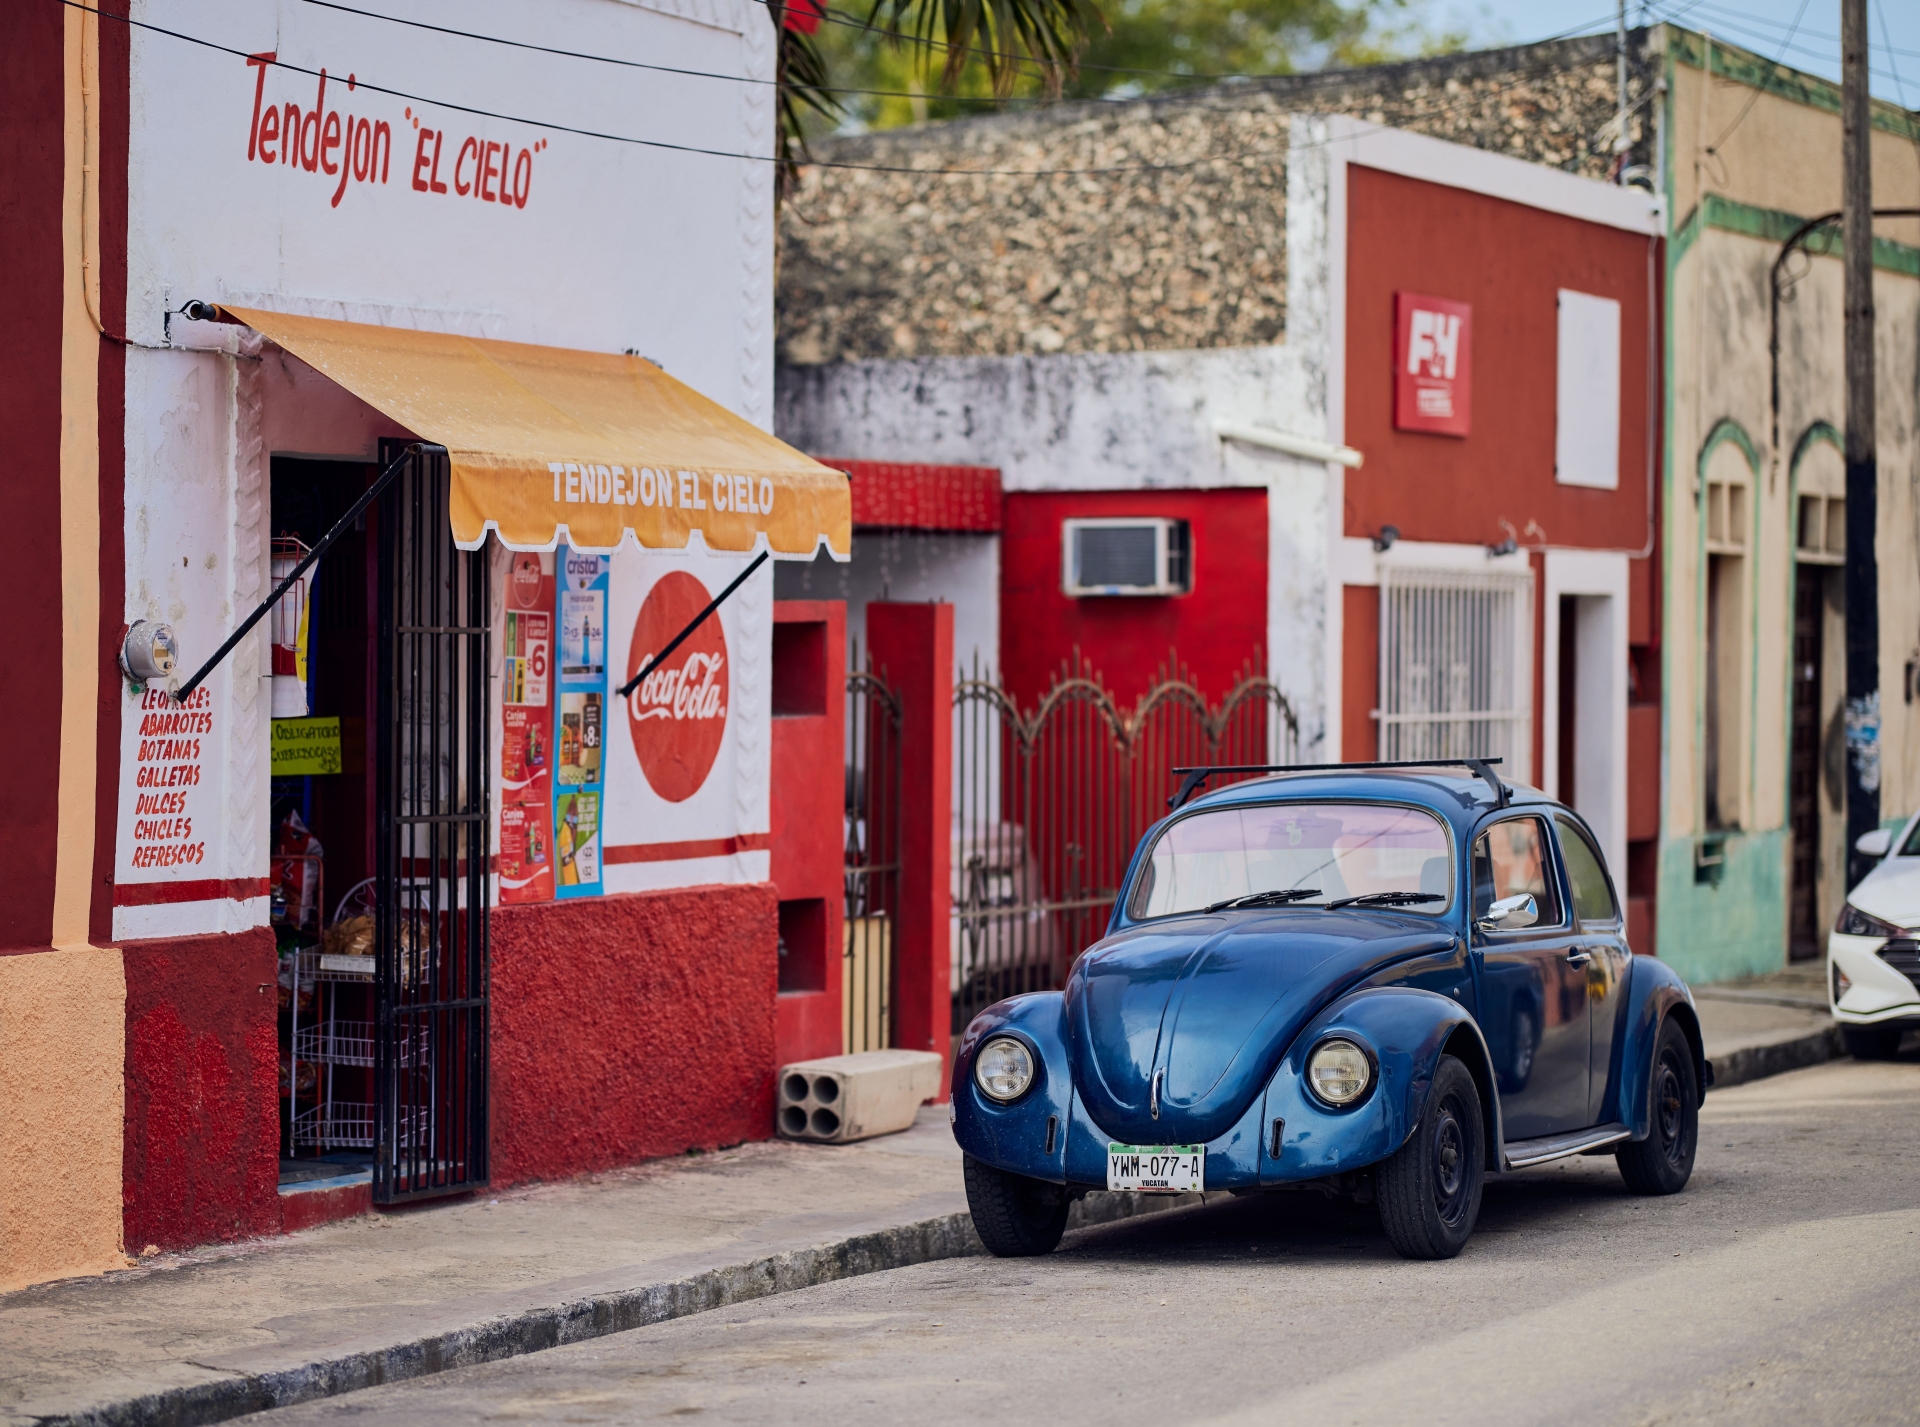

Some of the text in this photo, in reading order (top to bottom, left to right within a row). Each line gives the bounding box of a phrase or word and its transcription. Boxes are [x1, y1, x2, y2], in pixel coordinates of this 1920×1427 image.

[247, 52, 390, 208] Tendejon
[547, 462, 774, 515] TENDEJON EL CIELO
[567, 556, 598, 574] cristal
[158, 686, 210, 710] OCE:
[631, 652, 725, 721] Coca-Cola
[139, 711, 212, 736] ABARROTES
[137, 738, 201, 762] BOTANAS
[136, 764, 201, 788] GALLETAS
[135, 791, 187, 815] DULCES
[134, 817, 192, 841] CHICLES
[131, 841, 205, 868] REFRESCOS
[1111, 1155, 1199, 1177] YWM-077-A
